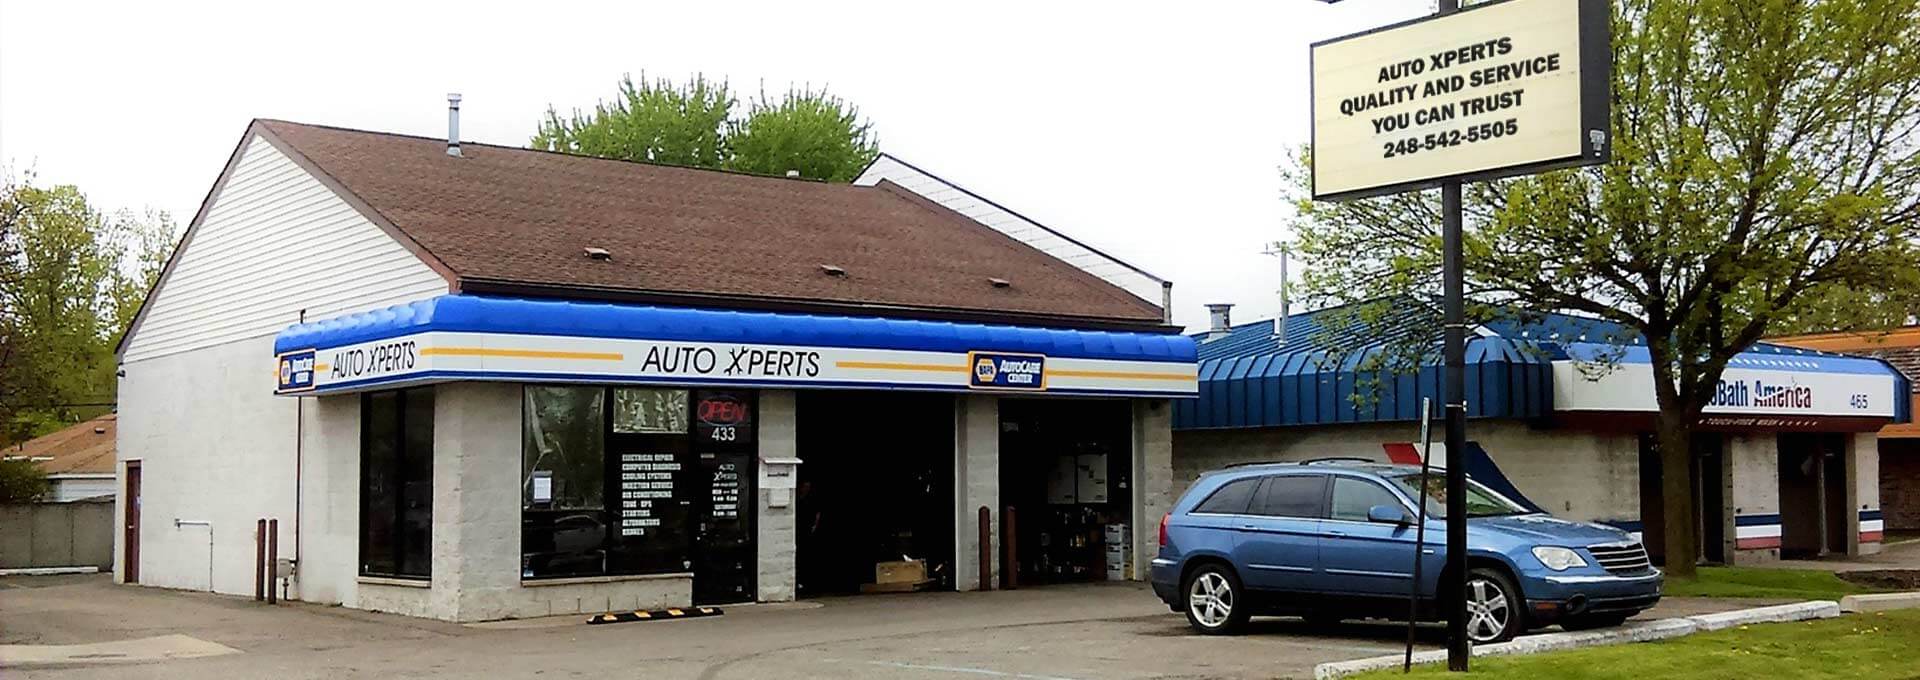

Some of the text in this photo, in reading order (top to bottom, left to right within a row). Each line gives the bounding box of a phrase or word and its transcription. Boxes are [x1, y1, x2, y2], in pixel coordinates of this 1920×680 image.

[1377, 36, 1513, 84] AUTO XPERTS
[1340, 53, 1561, 116] QUALITY AND SERVICE
[1371, 89, 1525, 135] YOU CAN TRUST
[1383, 118, 1519, 159] 248-542-5505
[331, 349, 365, 380] AUTO
[367, 341, 416, 374] XPERTS
[641, 346, 821, 377] AUTO XPERTS
[697, 400, 747, 421] OPEN
[1753, 380, 1812, 409] America
[1849, 393, 1869, 409] 465
[711, 427, 736, 441] 433
